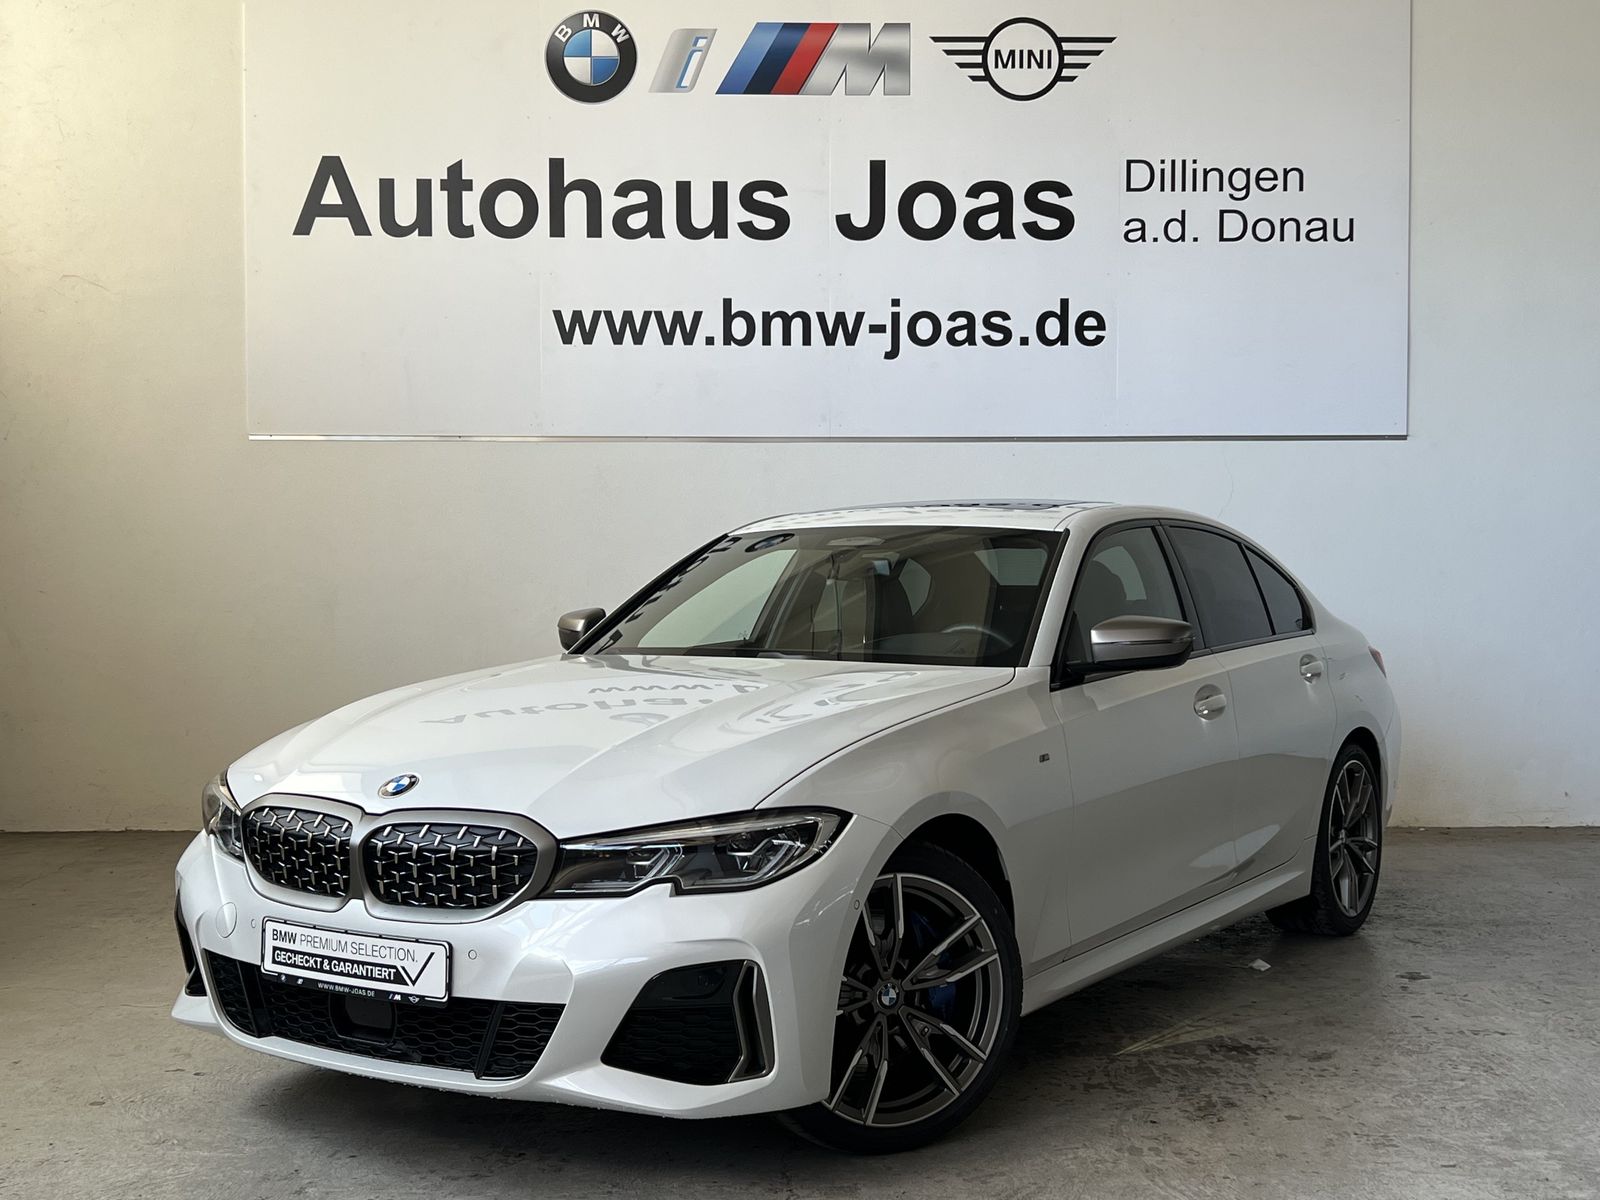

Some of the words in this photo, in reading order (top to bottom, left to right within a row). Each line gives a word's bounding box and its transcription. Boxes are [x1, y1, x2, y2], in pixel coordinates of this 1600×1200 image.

[554, 13, 630, 43] BMW
[993, 47, 1053, 70] MINI
[1125, 158, 1304, 202] Dillingen
[293, 155, 791, 241] Autohaus
[835, 159, 1075, 242] Joas
[1123, 209, 1199, 243] a.d.
[1218, 209, 1354, 243] Donau
[552, 297, 1107, 361] www.bmw-joas.de
[272, 928, 297, 945] BMW
[299, 933, 348, 954] PREMIUM
[350, 941, 418, 963] SELECTION.
[274, 950, 323, 970] GECHECKT
[322, 958, 330, 970] &
[331, 960, 397, 981] GARANTIERT
[317, 982, 376, 997] WWW.BMW-JOAS.DE
